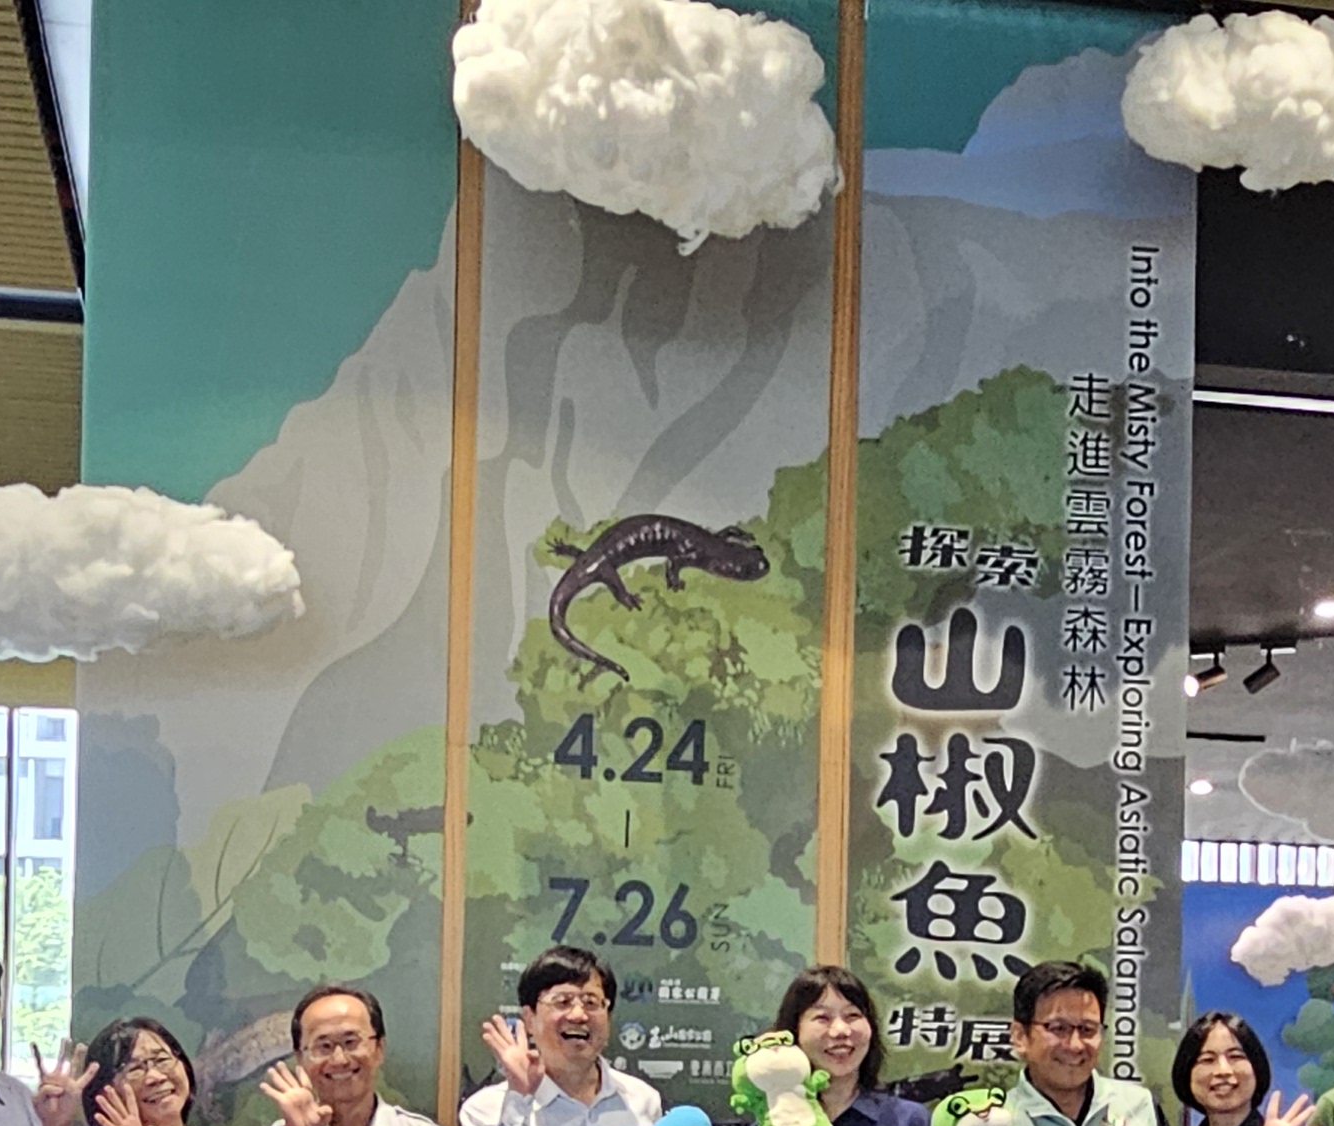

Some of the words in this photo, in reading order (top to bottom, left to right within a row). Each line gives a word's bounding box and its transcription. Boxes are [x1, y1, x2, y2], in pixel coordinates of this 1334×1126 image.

[1129, 245, 1160, 308] Into
[1128, 319, 1158, 373] the
[1120, 382, 1156, 470] Misty
[898, 525, 1040, 587] 探索
[1062, 371, 1111, 712] 走進雲霧森林
[553, 712, 710, 786] 4.24
[716, 755, 736, 790] FRI
[876, 606, 1039, 981] 山椒魚
[1117, 782, 1150, 897] Asiatic
[548, 876, 698, 950] 7.26
[710, 902, 730, 953] SUN
[1113, 907, 1147, 1082] Salamand
[887, 1006, 1018, 1063] 特展
